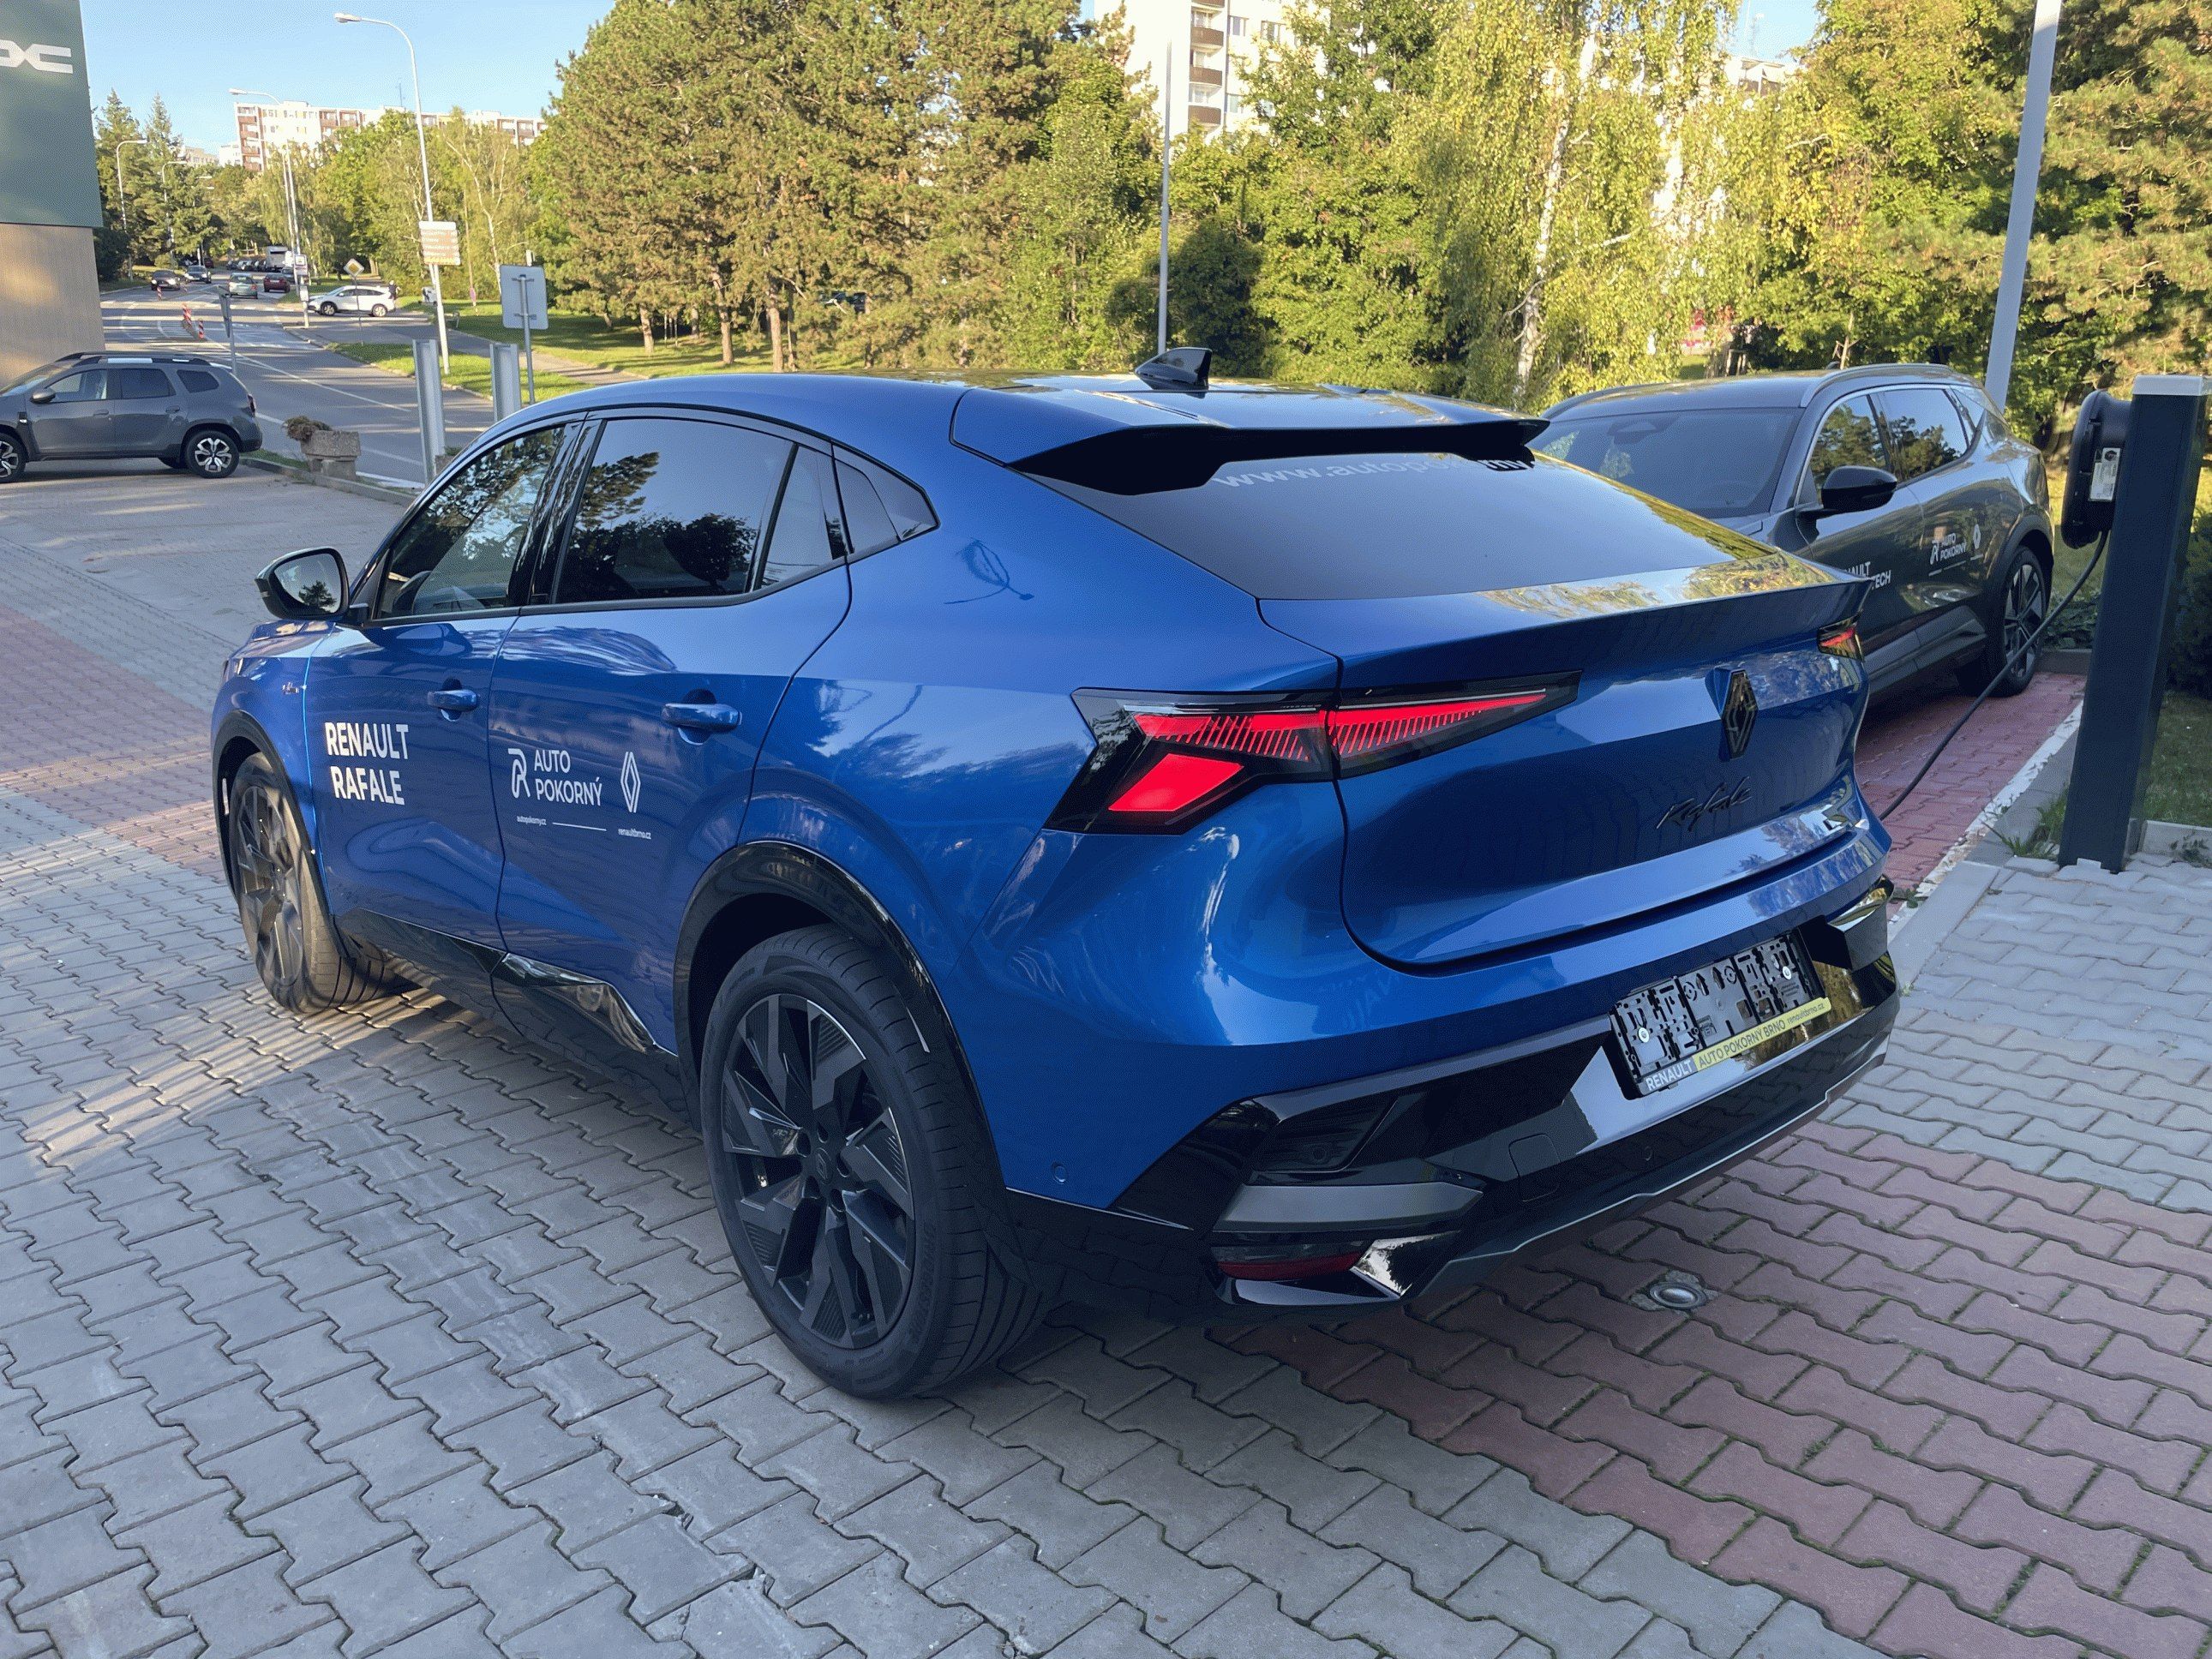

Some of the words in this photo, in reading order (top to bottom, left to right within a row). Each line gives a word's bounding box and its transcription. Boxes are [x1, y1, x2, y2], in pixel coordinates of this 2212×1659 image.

[325, 722, 409, 760] RENAULT
[534, 749, 571, 773] AUTO
[330, 766, 405, 806] RAFALE
[535, 776, 602, 806] POKORNÝ
[1646, 1060, 1693, 1091] RENAULT
[1699, 1048, 1724, 1069] AUTO
[1763, 1019, 1787, 1037] BRNO
